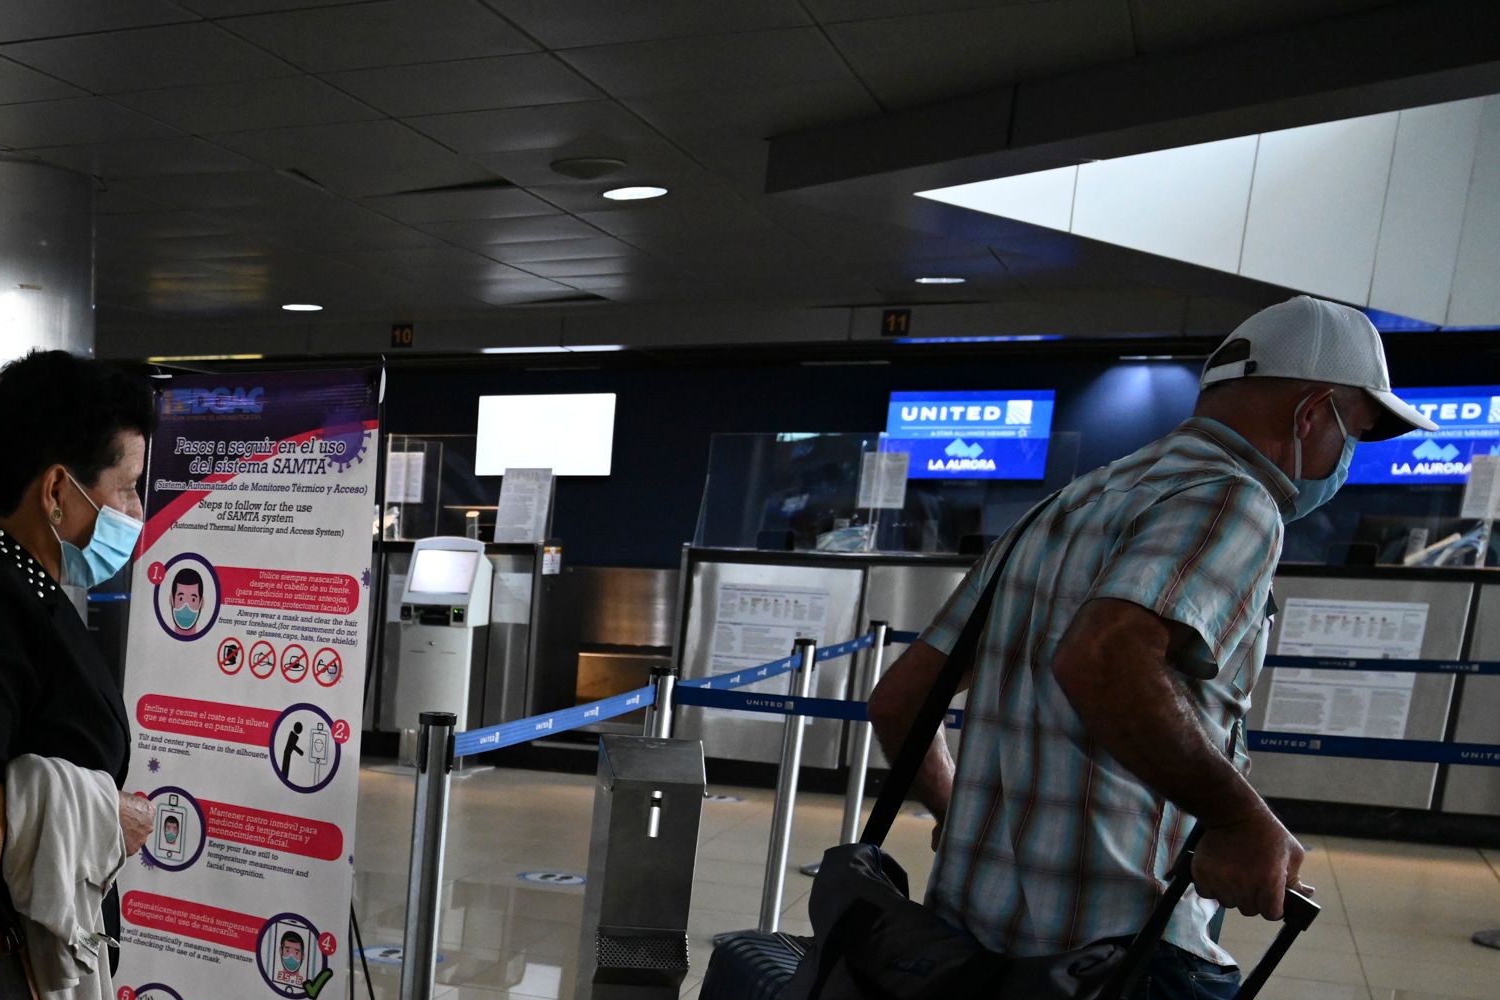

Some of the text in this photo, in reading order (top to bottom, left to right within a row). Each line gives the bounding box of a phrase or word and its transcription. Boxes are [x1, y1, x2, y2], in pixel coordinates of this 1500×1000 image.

[887, 314, 907, 332] 11
[394, 328, 412, 344] 10
[901, 406, 1001, 421] UNITED
[175, 438, 345, 457] Pasos a seguir en el uso
[190, 457, 326, 474] del sistema SAMTA
[927, 459, 996, 470] LA AURORA
[1391, 463, 1412, 475] LA
[155, 480, 368, 496] (Sistema Automatizado de Monitoreo Térmico y Acceso)
[199, 499, 312, 512] Steps to follow for the use
[217, 512, 294, 525] of SAMTA system
[171, 522, 344, 538] (Automated Thermal Monitoring and Access System)
[151, 566, 163, 580] 1.
[259, 571, 350, 586] Utilice siempre mascarilla y
[746, 699, 783, 708] UNITED
[144, 703, 169, 714] Incline
[175, 708, 198, 718] centre
[199, 711, 207, 719] el
[237, 716, 245, 725] la
[334, 724, 348, 739] 2.
[1261, 738, 1307, 748] UNITED
[1461, 751, 1500, 761] UNITE
[209, 807, 318, 835] Mantener rostro inmóvil para
[321, 936, 335, 952] 4.
